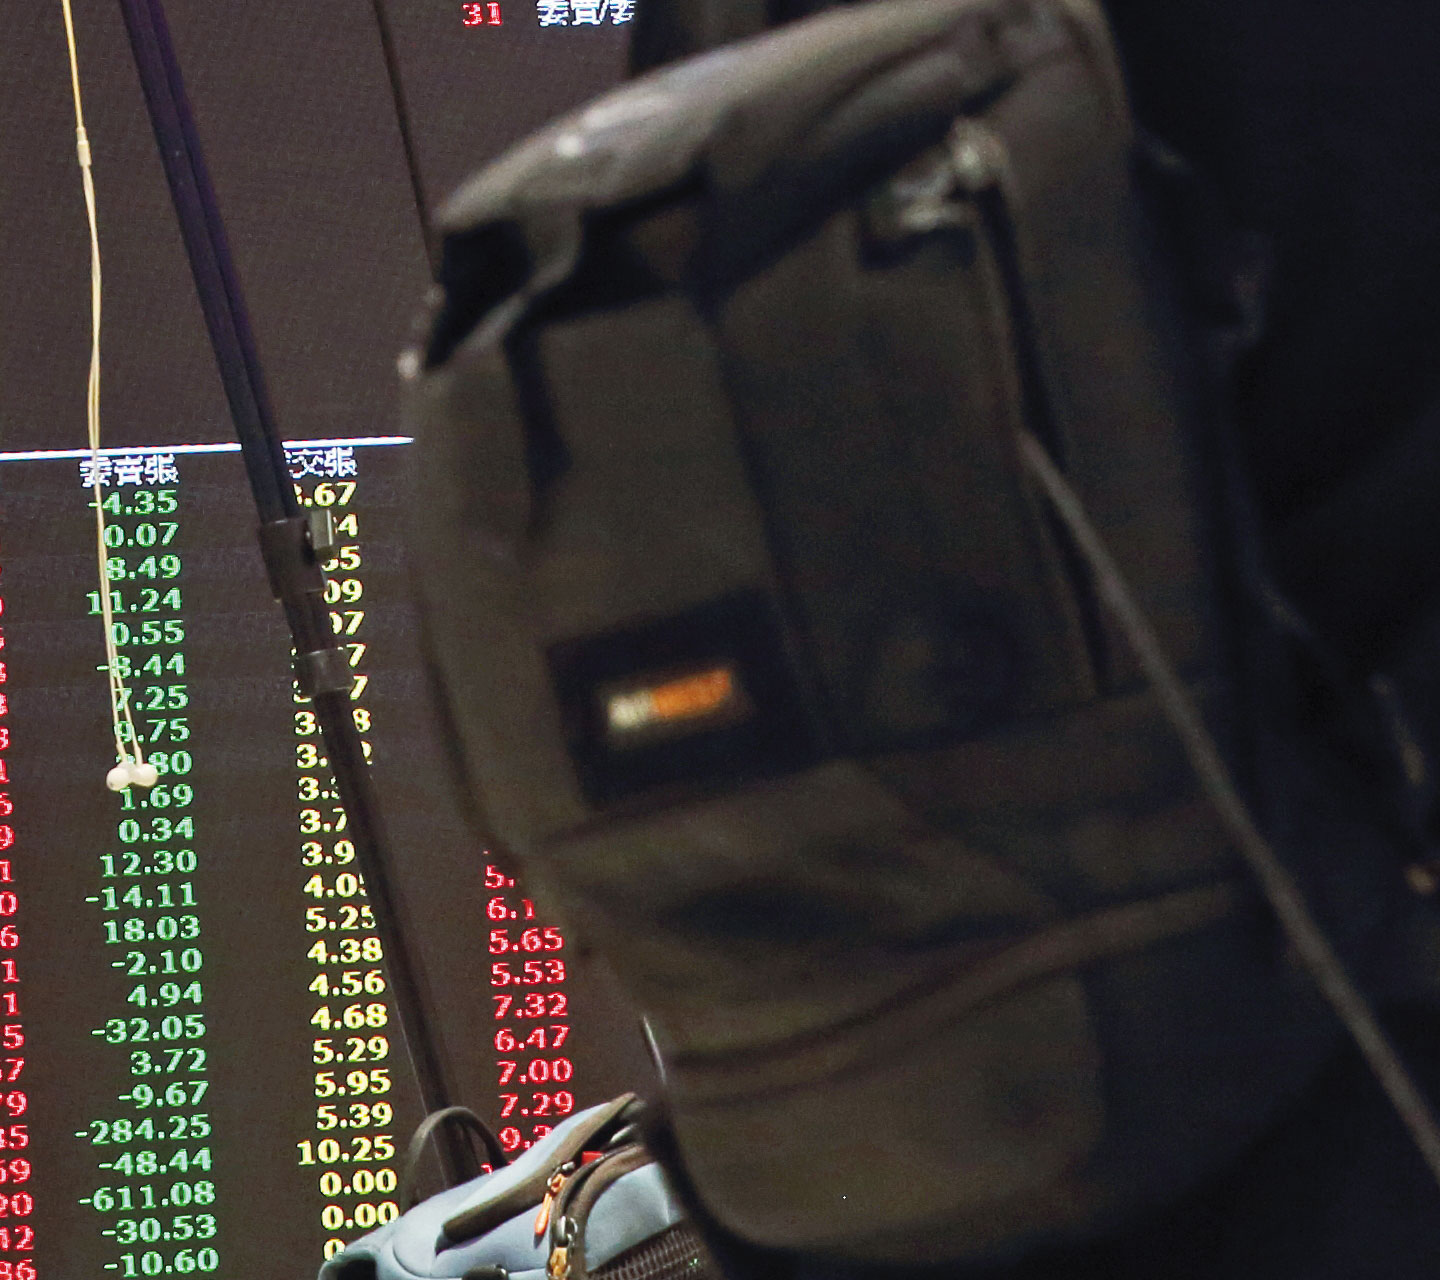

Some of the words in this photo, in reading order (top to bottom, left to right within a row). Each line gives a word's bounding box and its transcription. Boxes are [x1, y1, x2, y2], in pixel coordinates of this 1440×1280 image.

[462, 2, 503, 27] 31
[100, 850, 197, 877] 12.30
[86, 882, 197, 910] -14.11
[309, 969, 385, 997] 4.56
[492, 991, 568, 1020] 7.32
[92, 1014, 206, 1043] -32.05
[494, 1024, 570, 1053] 6.47
[313, 1035, 389, 1064] 5.29
[496, 1057, 574, 1086] 7.00
[75, 1114, 211, 1144] -284.25
[297, 1134, 395, 1165] 10.25
[78, 1181, 215, 1211] -611.08
